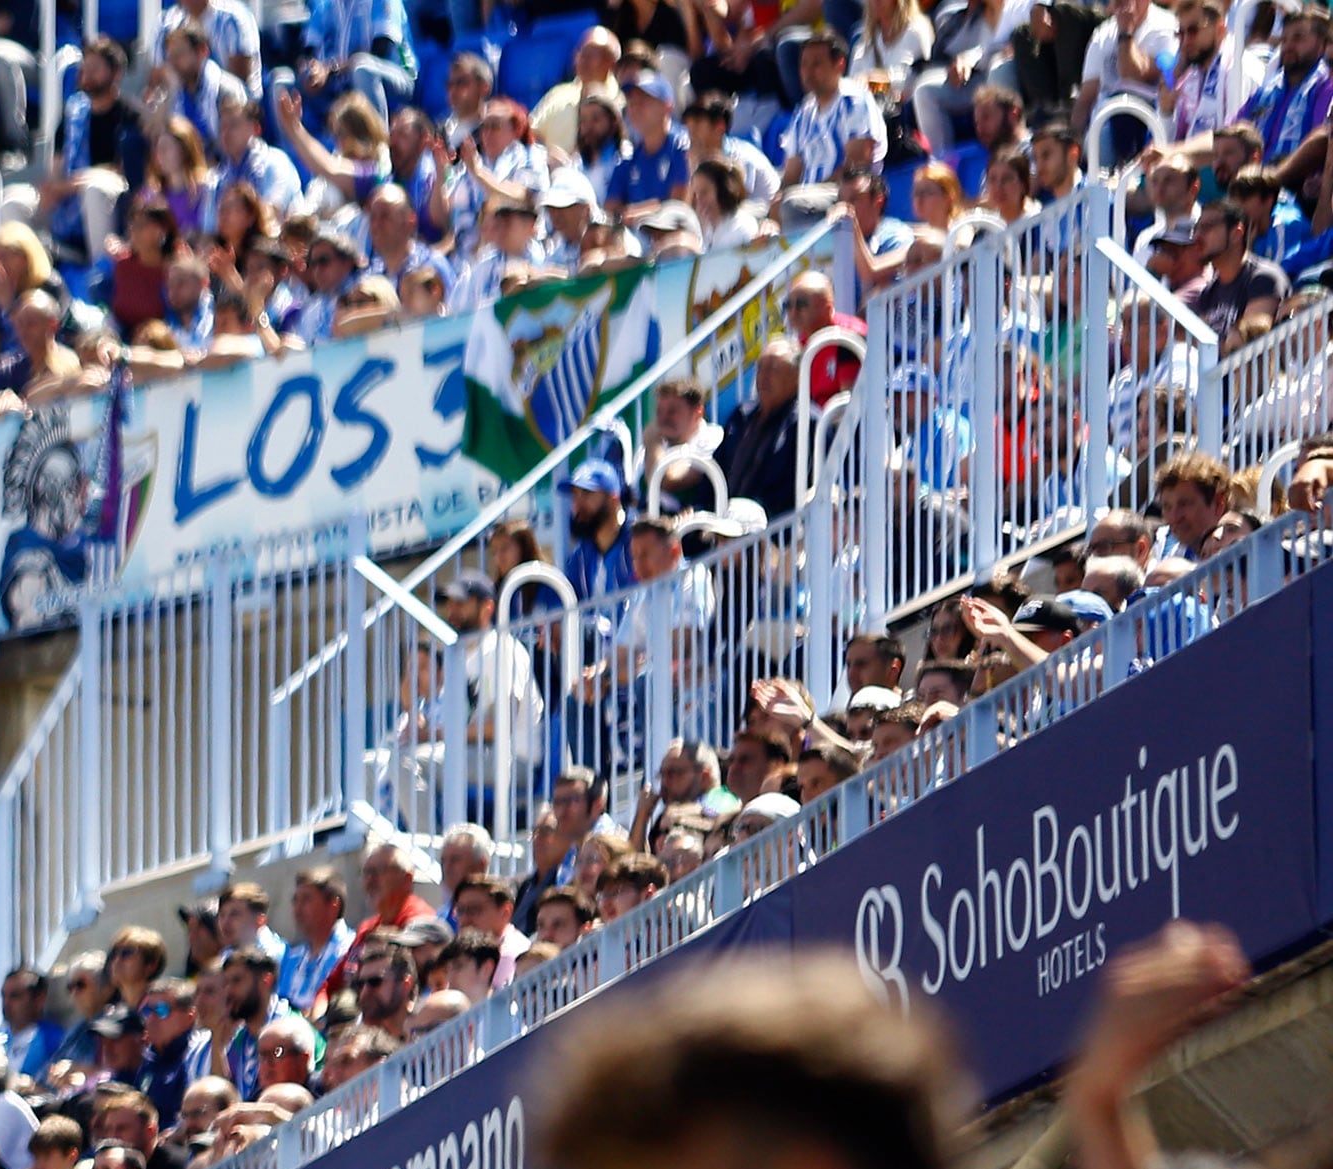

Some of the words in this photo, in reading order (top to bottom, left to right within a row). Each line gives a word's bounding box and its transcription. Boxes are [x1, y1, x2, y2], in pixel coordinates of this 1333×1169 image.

[174, 357, 398, 523] LOS
[920, 743, 1240, 995] SohoBoutique
[1037, 922, 1107, 997] HOTELS
